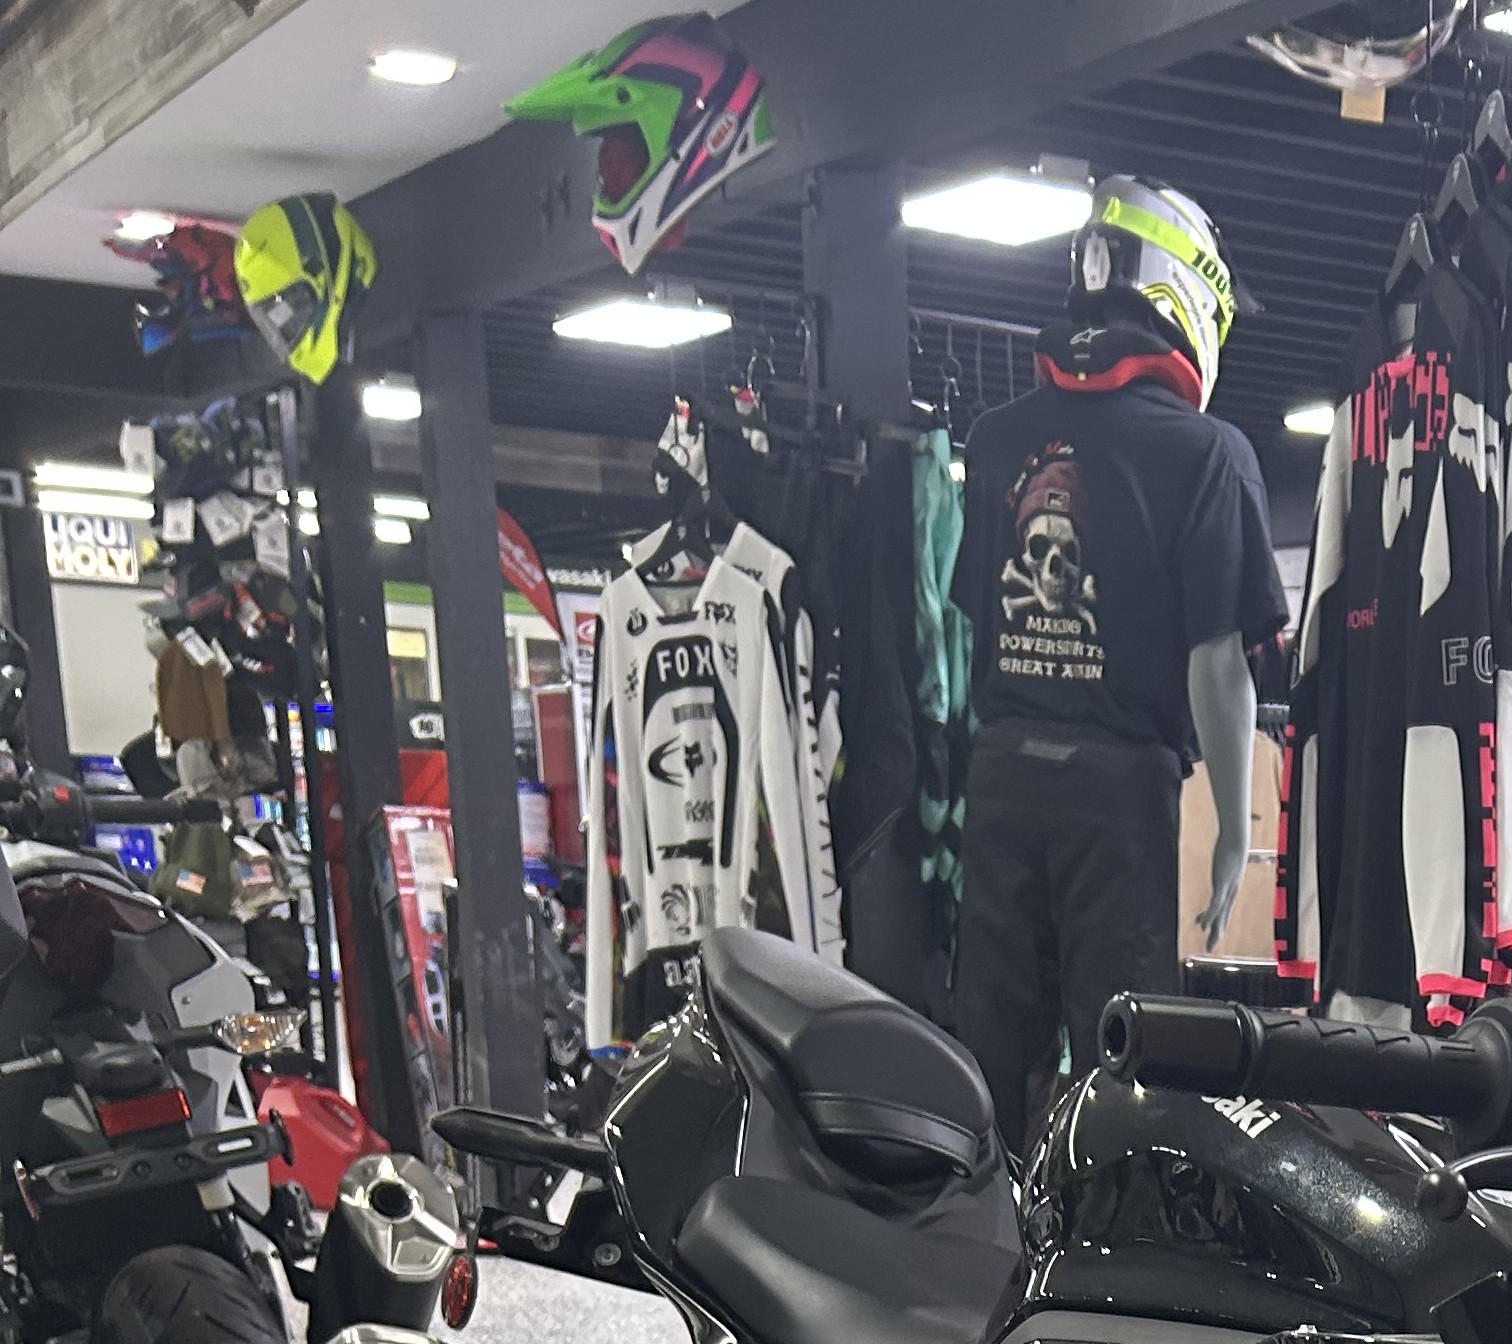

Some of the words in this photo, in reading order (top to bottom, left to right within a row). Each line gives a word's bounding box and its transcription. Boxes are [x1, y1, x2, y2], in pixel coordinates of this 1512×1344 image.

[49, 541, 133, 577] MOLY
[656, 644, 714, 683] FOX
[1201, 1095, 1281, 1139] aki
